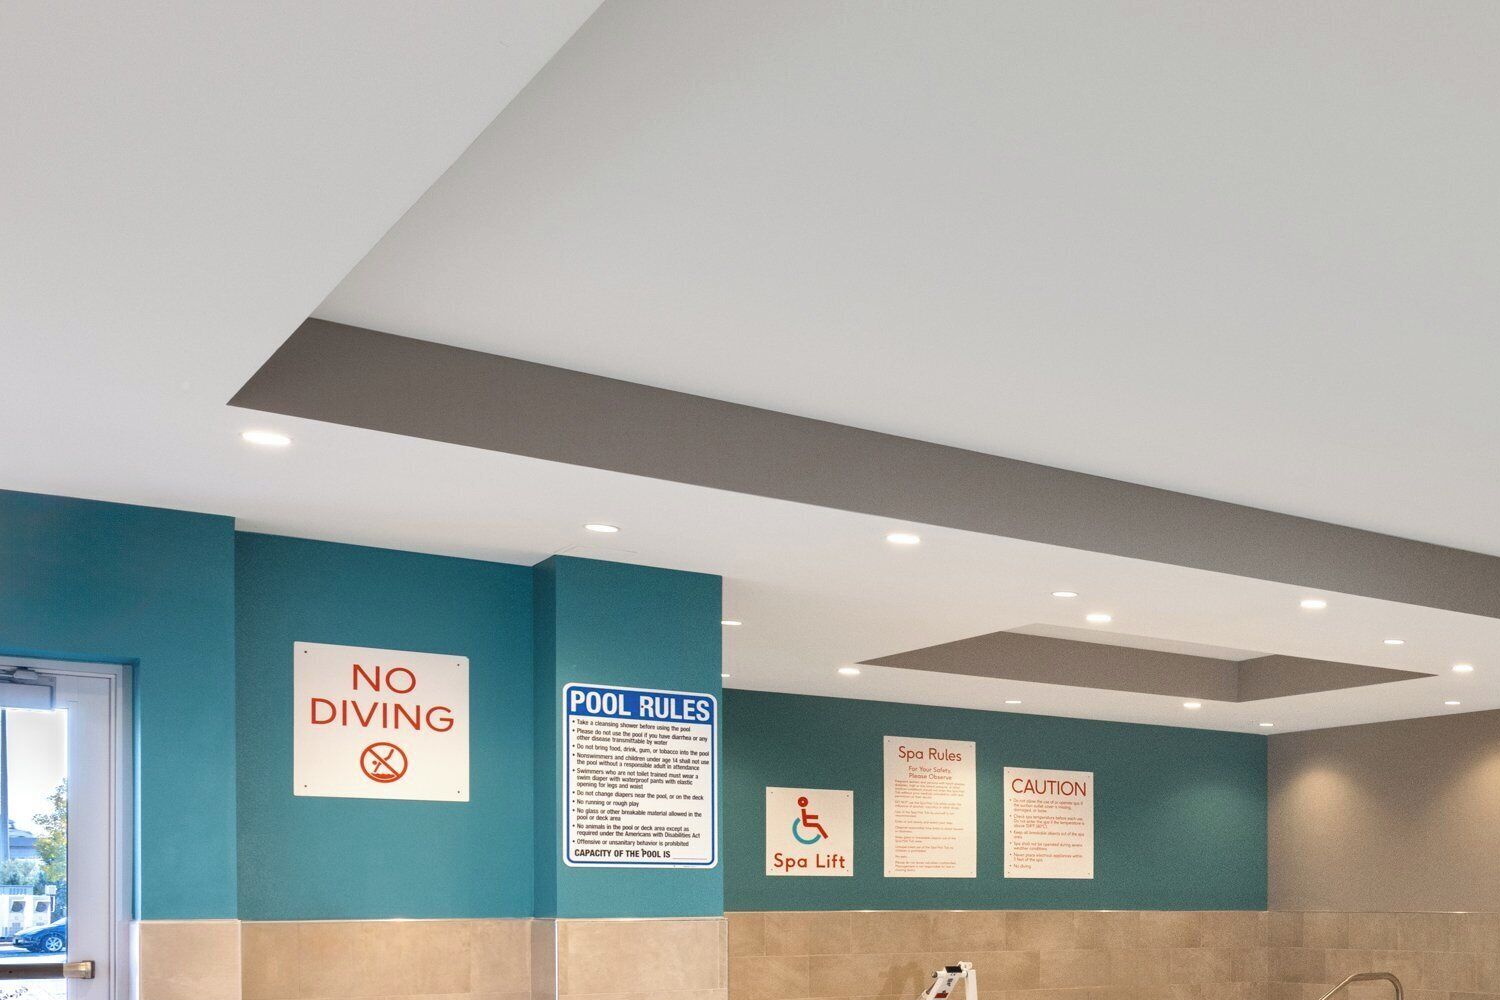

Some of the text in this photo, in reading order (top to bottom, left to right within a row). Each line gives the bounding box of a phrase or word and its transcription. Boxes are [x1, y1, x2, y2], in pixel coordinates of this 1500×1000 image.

[352, 664, 416, 694] NO
[570, 690, 710, 722] POOL RULES
[310, 697, 454, 732] DIVING
[595, 721, 618, 729] cleansing
[680, 726, 691, 734] pool
[632, 731, 643, 739] pool
[595, 744, 608, 752] bring
[699, 750, 709, 758] pool
[898, 746, 962, 762] Spa Rules
[587, 759, 597, 767] pool
[592, 775, 608, 783] diaper
[577, 781, 597, 789] opening
[1012, 778, 1086, 796] CAUTION
[615, 791, 633, 799] diapers
[585, 799, 605, 807] running
[629, 800, 639, 808] play
[666, 825, 682, 833] except
[609, 839, 635, 847] unsanitary
[665, 840, 689, 848] prohibited
[575, 849, 611, 857] CAPACITY
[663, 850, 671, 858] IS
[773, 852, 846, 872] Spa Lift
